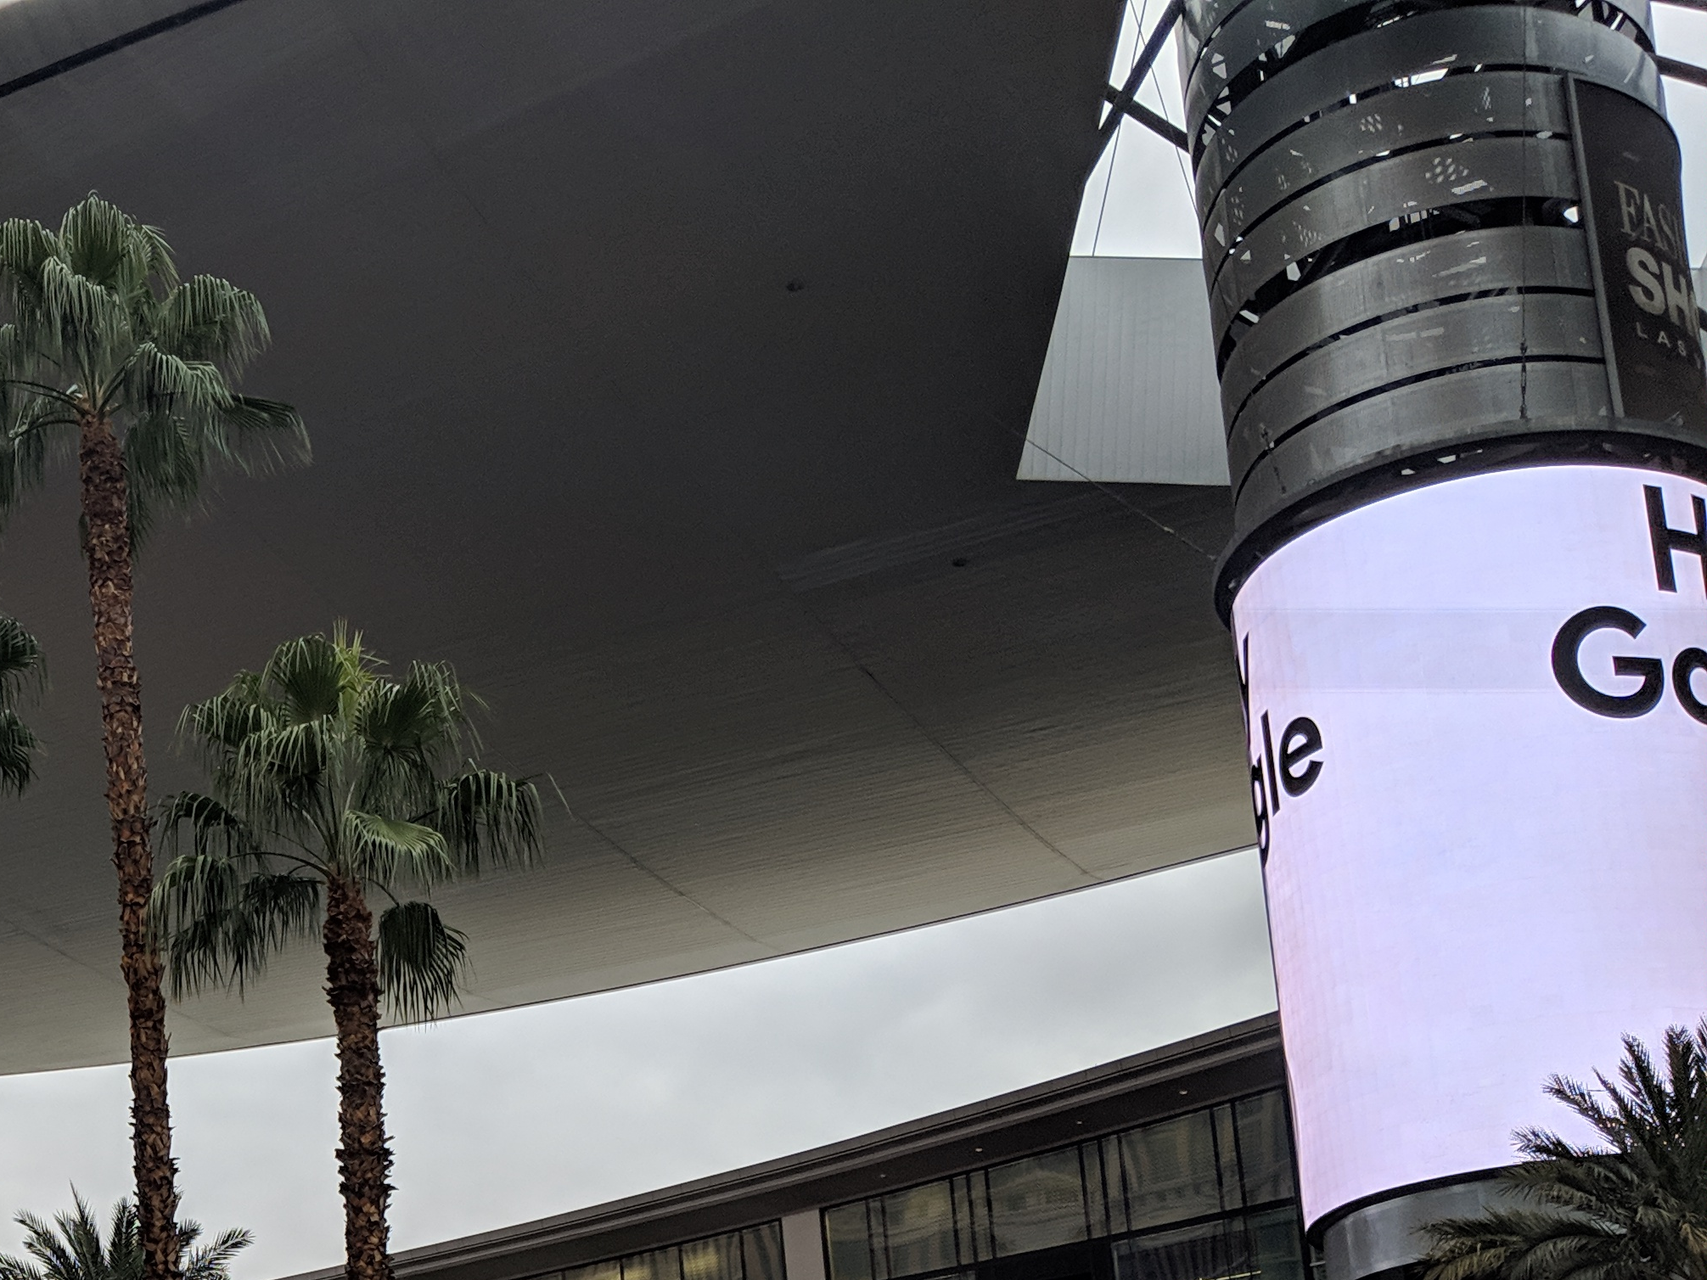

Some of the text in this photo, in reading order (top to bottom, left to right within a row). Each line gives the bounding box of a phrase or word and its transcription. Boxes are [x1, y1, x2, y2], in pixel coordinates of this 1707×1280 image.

[1614, 180, 1687, 270] FAS
[1626, 246, 1699, 338] SH
[1636, 321, 1687, 356] LAS
[1251, 709, 1324, 870] gle
